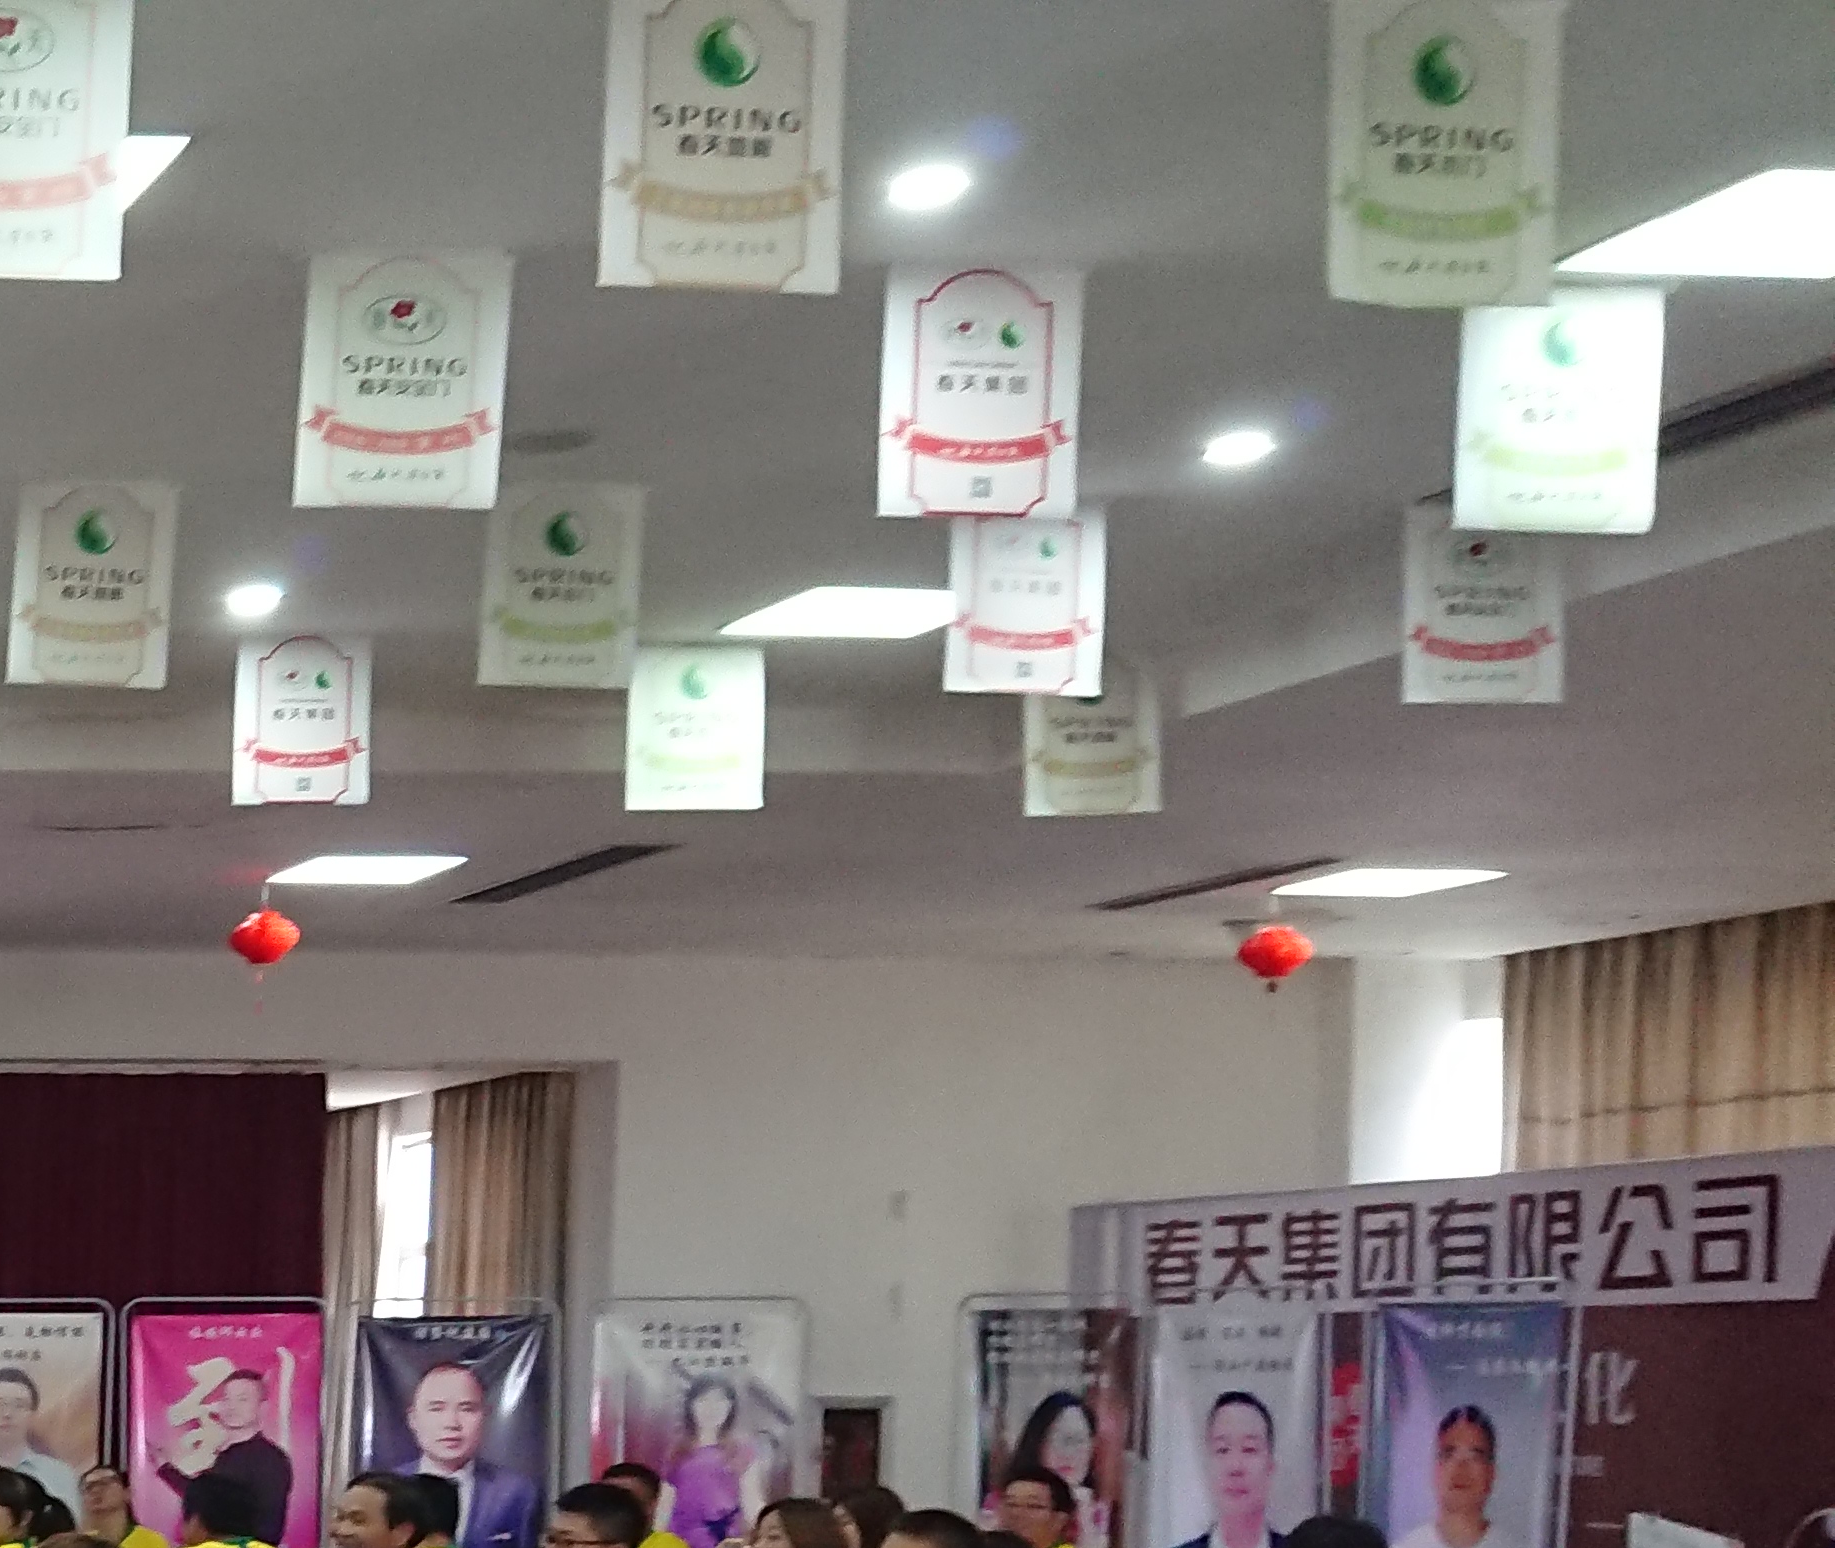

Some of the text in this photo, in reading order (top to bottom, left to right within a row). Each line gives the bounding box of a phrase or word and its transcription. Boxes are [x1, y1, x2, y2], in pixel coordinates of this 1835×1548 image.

[652, 103, 802, 133] SPRING
[1368, 122, 1515, 152] SPRING
[342, 355, 469, 377] SPRING
[45, 564, 145, 585] SPRING
[1145, 1173, 1781, 1305] 春天集团有限公司
